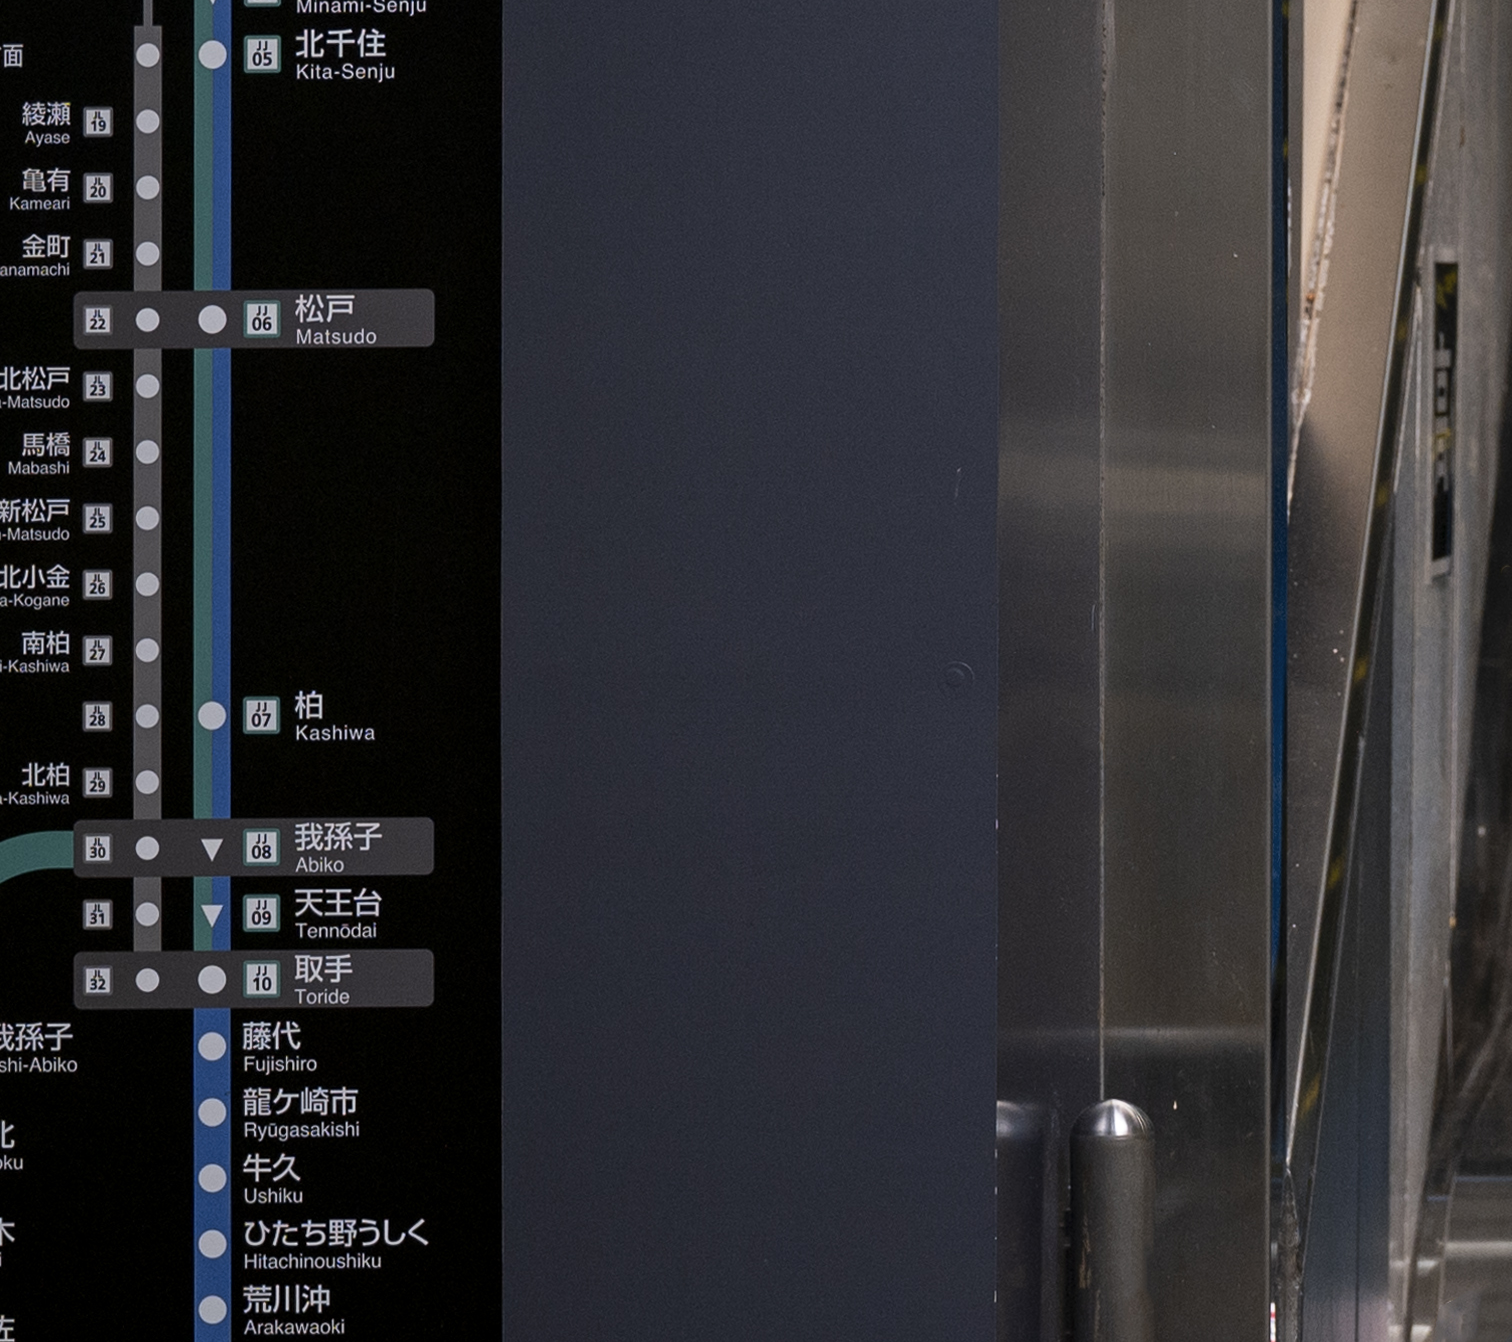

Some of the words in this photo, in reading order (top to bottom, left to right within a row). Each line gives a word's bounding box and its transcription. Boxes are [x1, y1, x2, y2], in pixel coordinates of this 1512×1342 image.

[296, 29, 386, 58] 北千住
[297, 63, 394, 83] Kita-Senju
[22, 102, 70, 126] 綾瀬
[91, 119, 106, 131] 19
[25, 131, 70, 147] Ayase
[22, 168, 70, 192] 亀有
[10, 197, 70, 210] Kameari
[23, 234, 70, 258] 金町
[295, 294, 355, 323] 松戸
[297, 328, 376, 344] Matsudo
[22, 432, 70, 456] 馬橋
[9, 461, 69, 474] Mabashi
[22, 631, 69, 654] 南柏
[295, 691, 322, 719] 柏
[296, 725, 375, 740] Kashiwa
[22, 762, 69, 786] 北柏
[295, 822, 382, 851] 我孫子
[296, 857, 344, 872] Abiko
[295, 888, 382, 917] 天王台
[295, 922, 376, 938] Tennōdai
[295, 954, 353, 983] 取手
[294, 989, 350, 1004] Toride
[243, 1021, 301, 1050] 藤代
[244, 1056, 317, 1075] Fujishiro
[245, 1121, 359, 1141] Ryūgasakishi
[243, 1153, 300, 1182] 牛久
[245, 1188, 302, 1204] Ushiku
[245, 1219, 428, 1247] ひたち野うしく
[245, 1253, 381, 1269] Hitachinoushiku
[243, 1284, 330, 1313] 荒川沖
[244, 1319, 344, 1335] Arakawaoki
